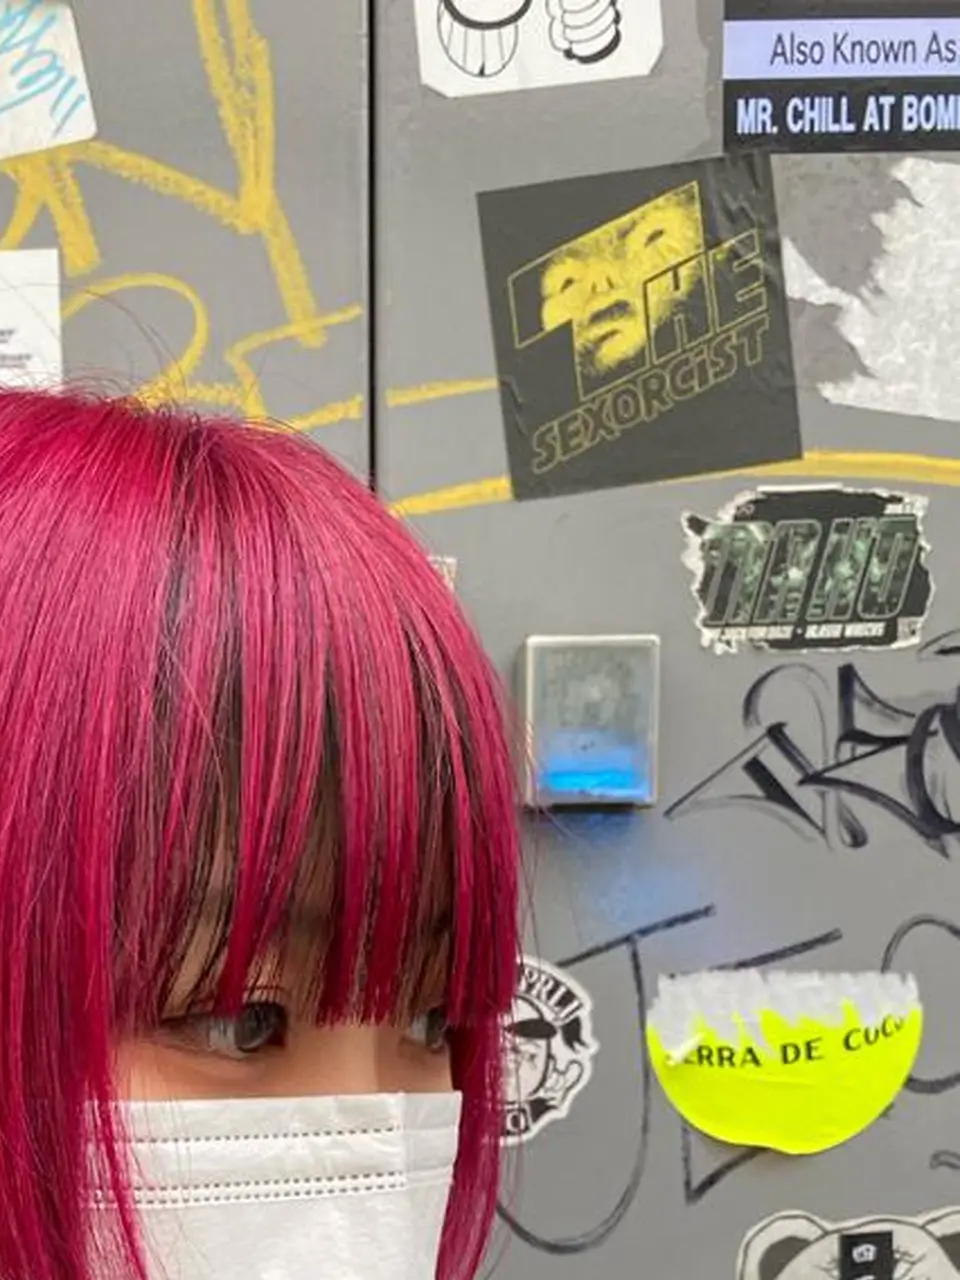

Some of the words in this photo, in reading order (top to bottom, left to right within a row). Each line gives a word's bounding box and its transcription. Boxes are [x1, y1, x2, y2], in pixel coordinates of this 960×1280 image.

[770, 31, 825, 66] Also
[832, 31, 917, 65] Known
[736, 97, 778, 134] MR.
[786, 95, 856, 133] CHILL
[863, 95, 895, 131] AT
[902, 94, 960, 131] BOM
[781, 1037, 823, 1065] DE
